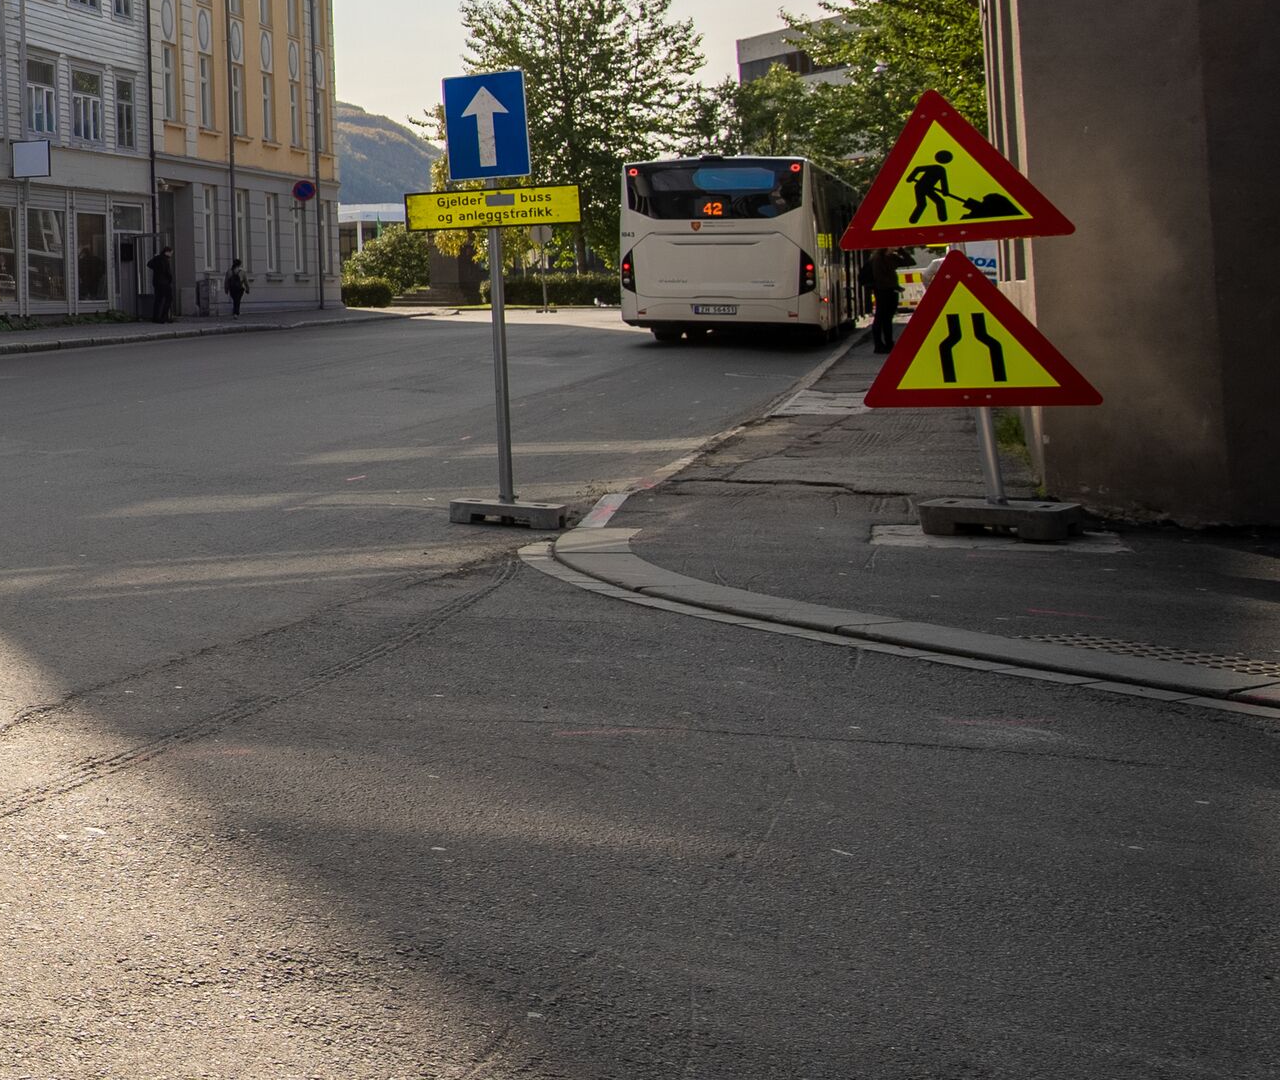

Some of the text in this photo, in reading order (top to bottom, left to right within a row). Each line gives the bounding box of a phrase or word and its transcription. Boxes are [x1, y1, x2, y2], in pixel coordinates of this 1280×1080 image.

[436, 192, 552, 209] Gjelder buss
[703, 202, 723, 216] 42
[437, 206, 553, 224] og anleggstrafikk
